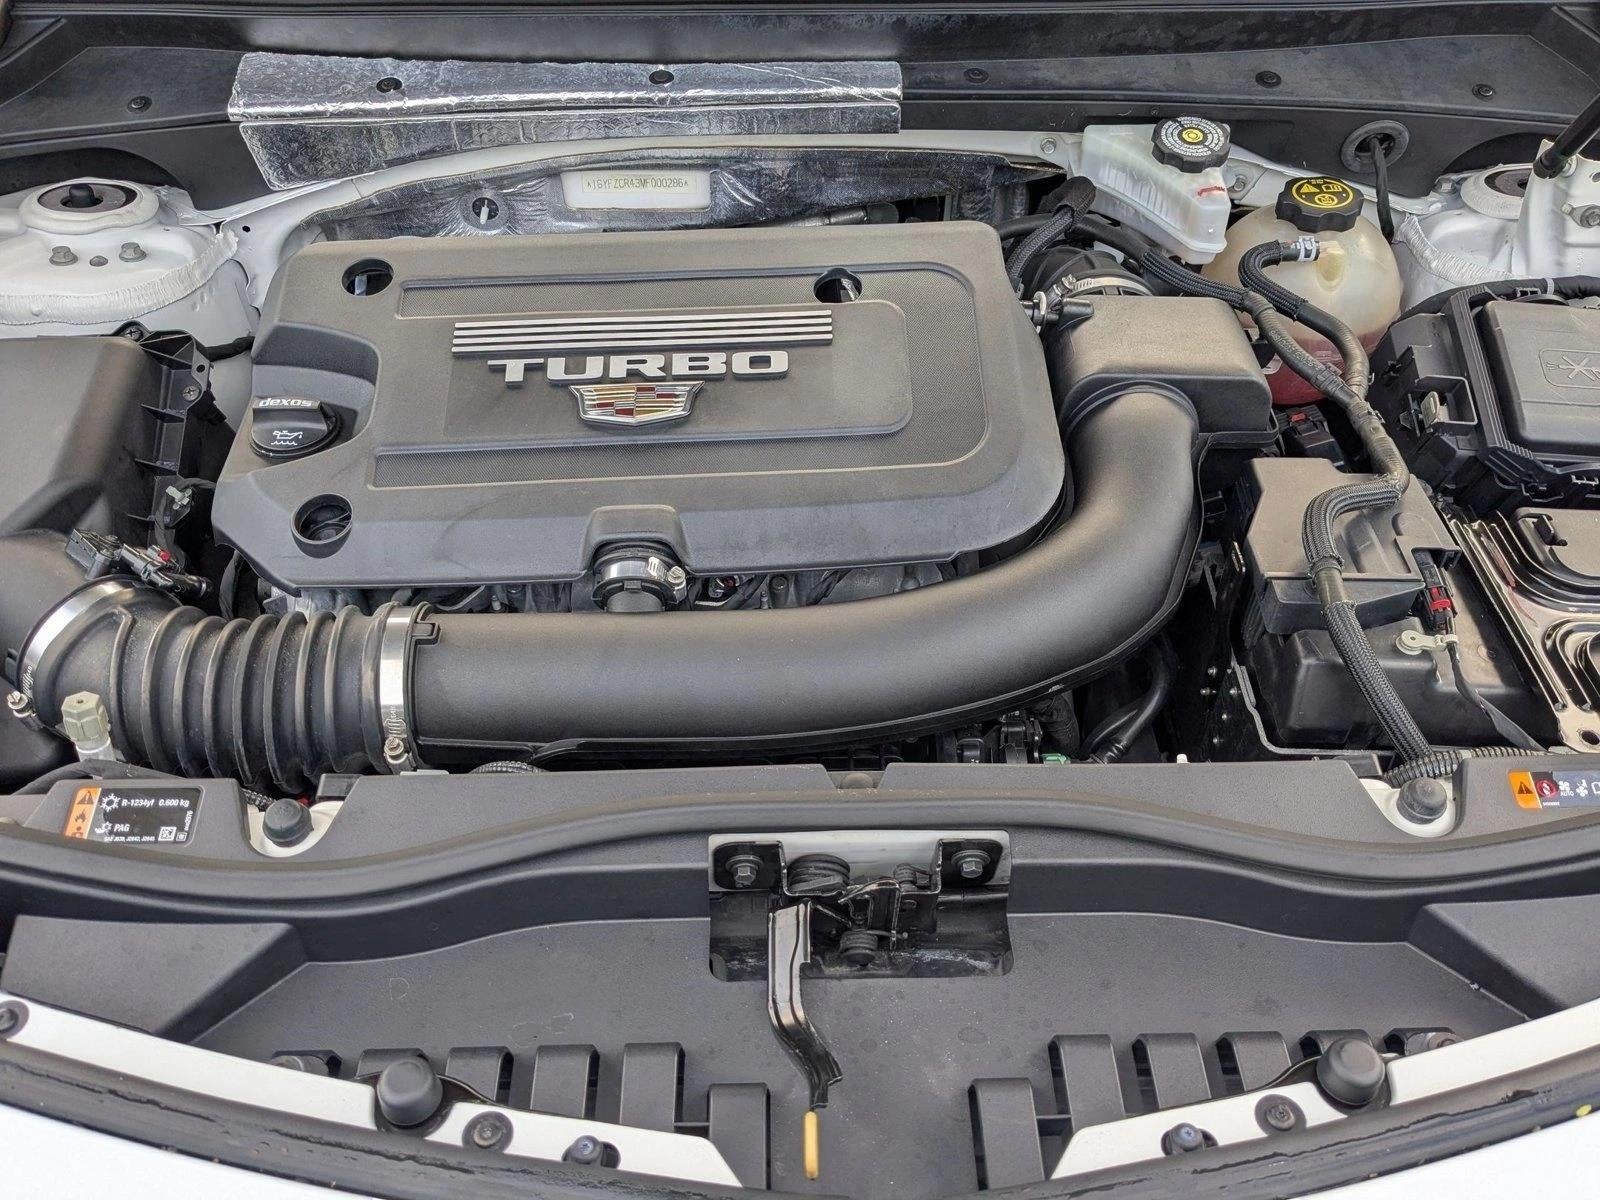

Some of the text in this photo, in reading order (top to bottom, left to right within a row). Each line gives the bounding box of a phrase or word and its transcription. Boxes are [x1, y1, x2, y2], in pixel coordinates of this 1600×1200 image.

[487, 350, 789, 386] TURBO
[259, 398, 312, 407] dexos
[121, 798, 190, 808] R-1234yf 0.600 kg
[114, 823, 130, 832] PAG
